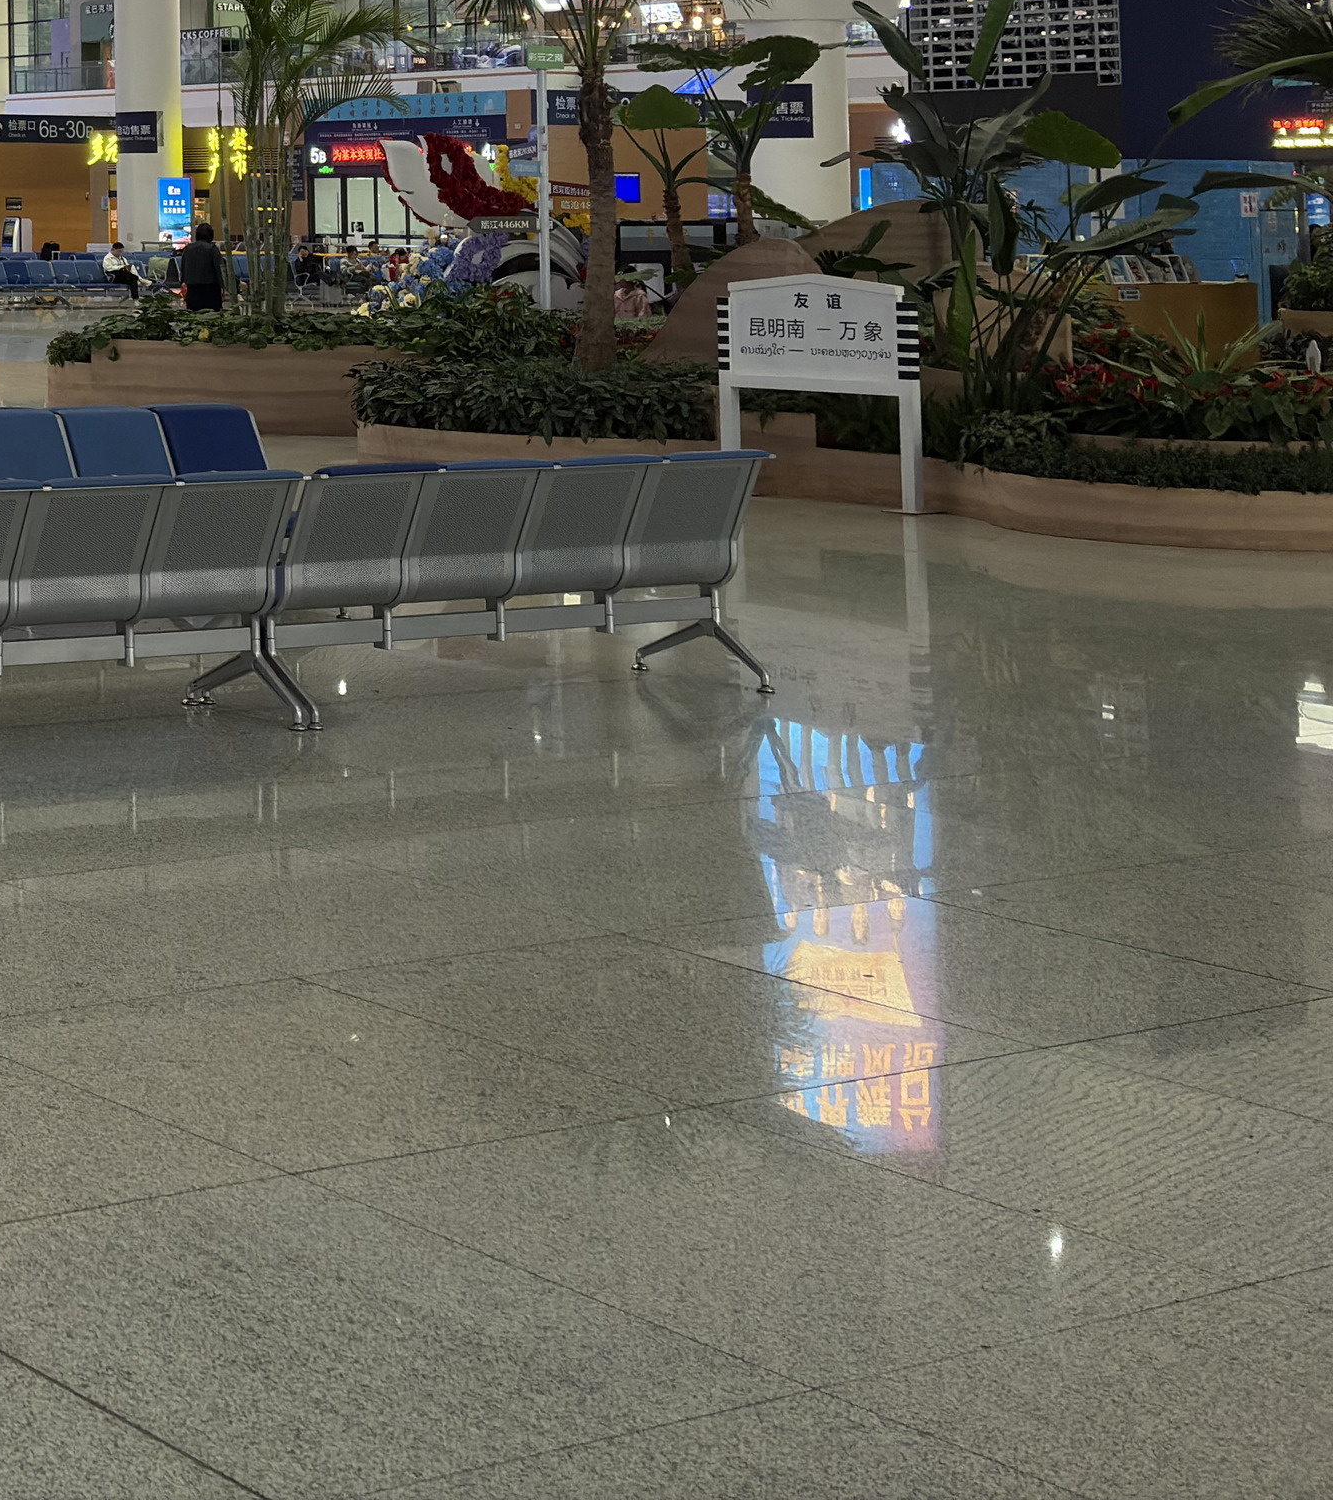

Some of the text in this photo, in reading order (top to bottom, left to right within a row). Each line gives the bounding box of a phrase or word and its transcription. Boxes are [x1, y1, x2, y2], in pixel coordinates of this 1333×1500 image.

[555, 96, 579, 110] 检票
[8, 119, 36, 131] 检票口
[310, 147, 327, 164] 5B
[794, 292, 842, 309] 友谊
[749, 317, 883, 341] 昆明南 万象
